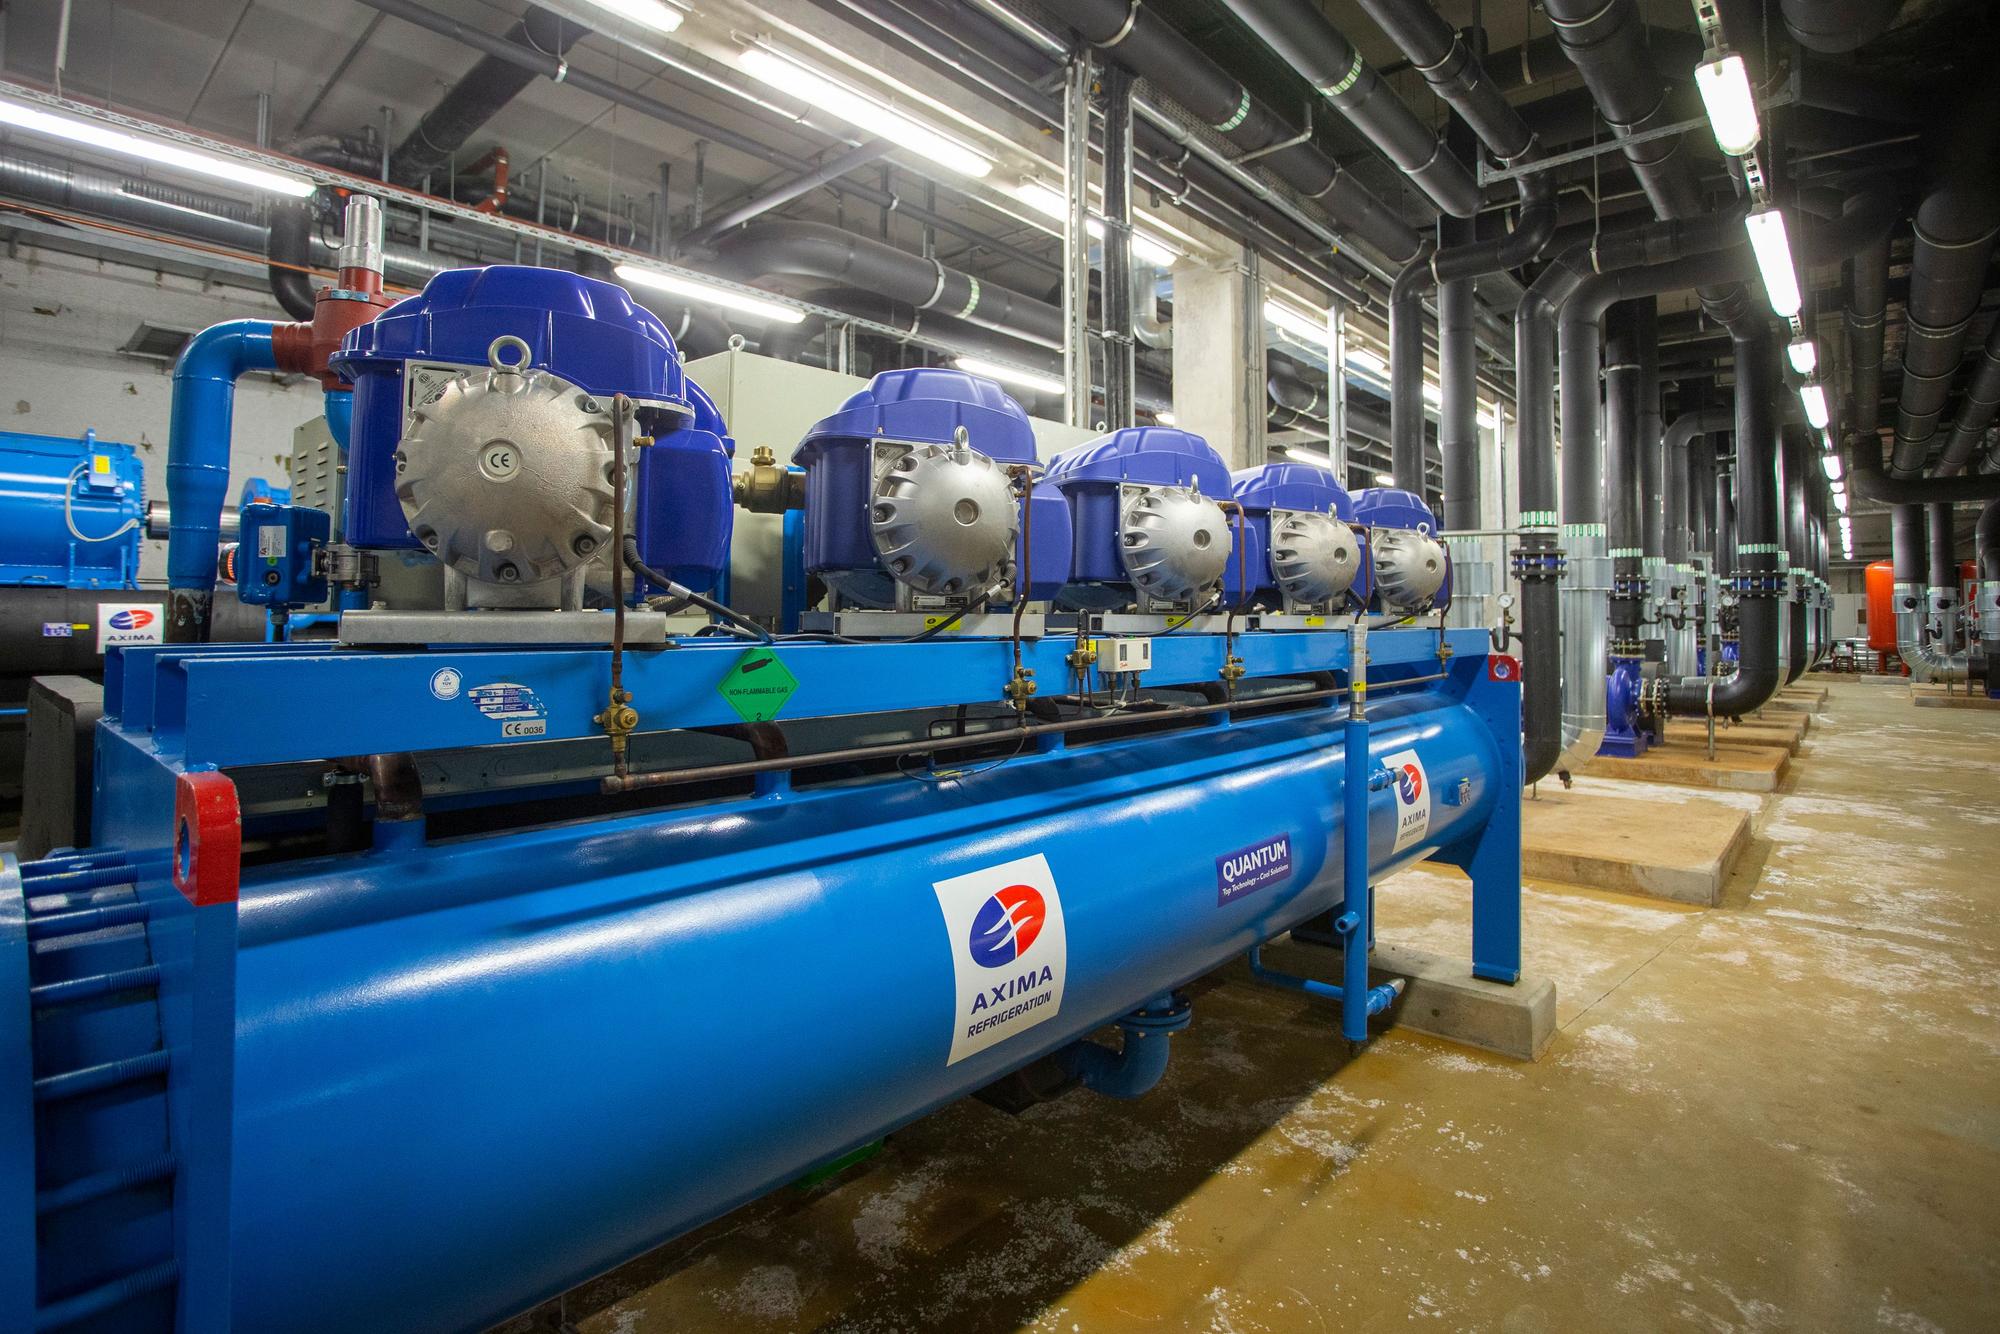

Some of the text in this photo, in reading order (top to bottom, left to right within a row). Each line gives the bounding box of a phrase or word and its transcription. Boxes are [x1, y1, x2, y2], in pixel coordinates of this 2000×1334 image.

[729, 687, 776, 696] NON-FLAMMABLE
[756, 712, 762, 721] 2
[524, 726, 543, 734] 0036
[1401, 808, 1426, 828] AXIMA
[1223, 840, 1287, 882] QUANTUM
[1222, 888, 1232, 896] Top
[1232, 878, 1256, 891] Technology
[1260, 872, 1270, 880] Cool
[1270, 864, 1289, 876] Solutions
[971, 965, 1053, 1015] AXIMA
[967, 990, 1052, 1038] REFRIGERATION
